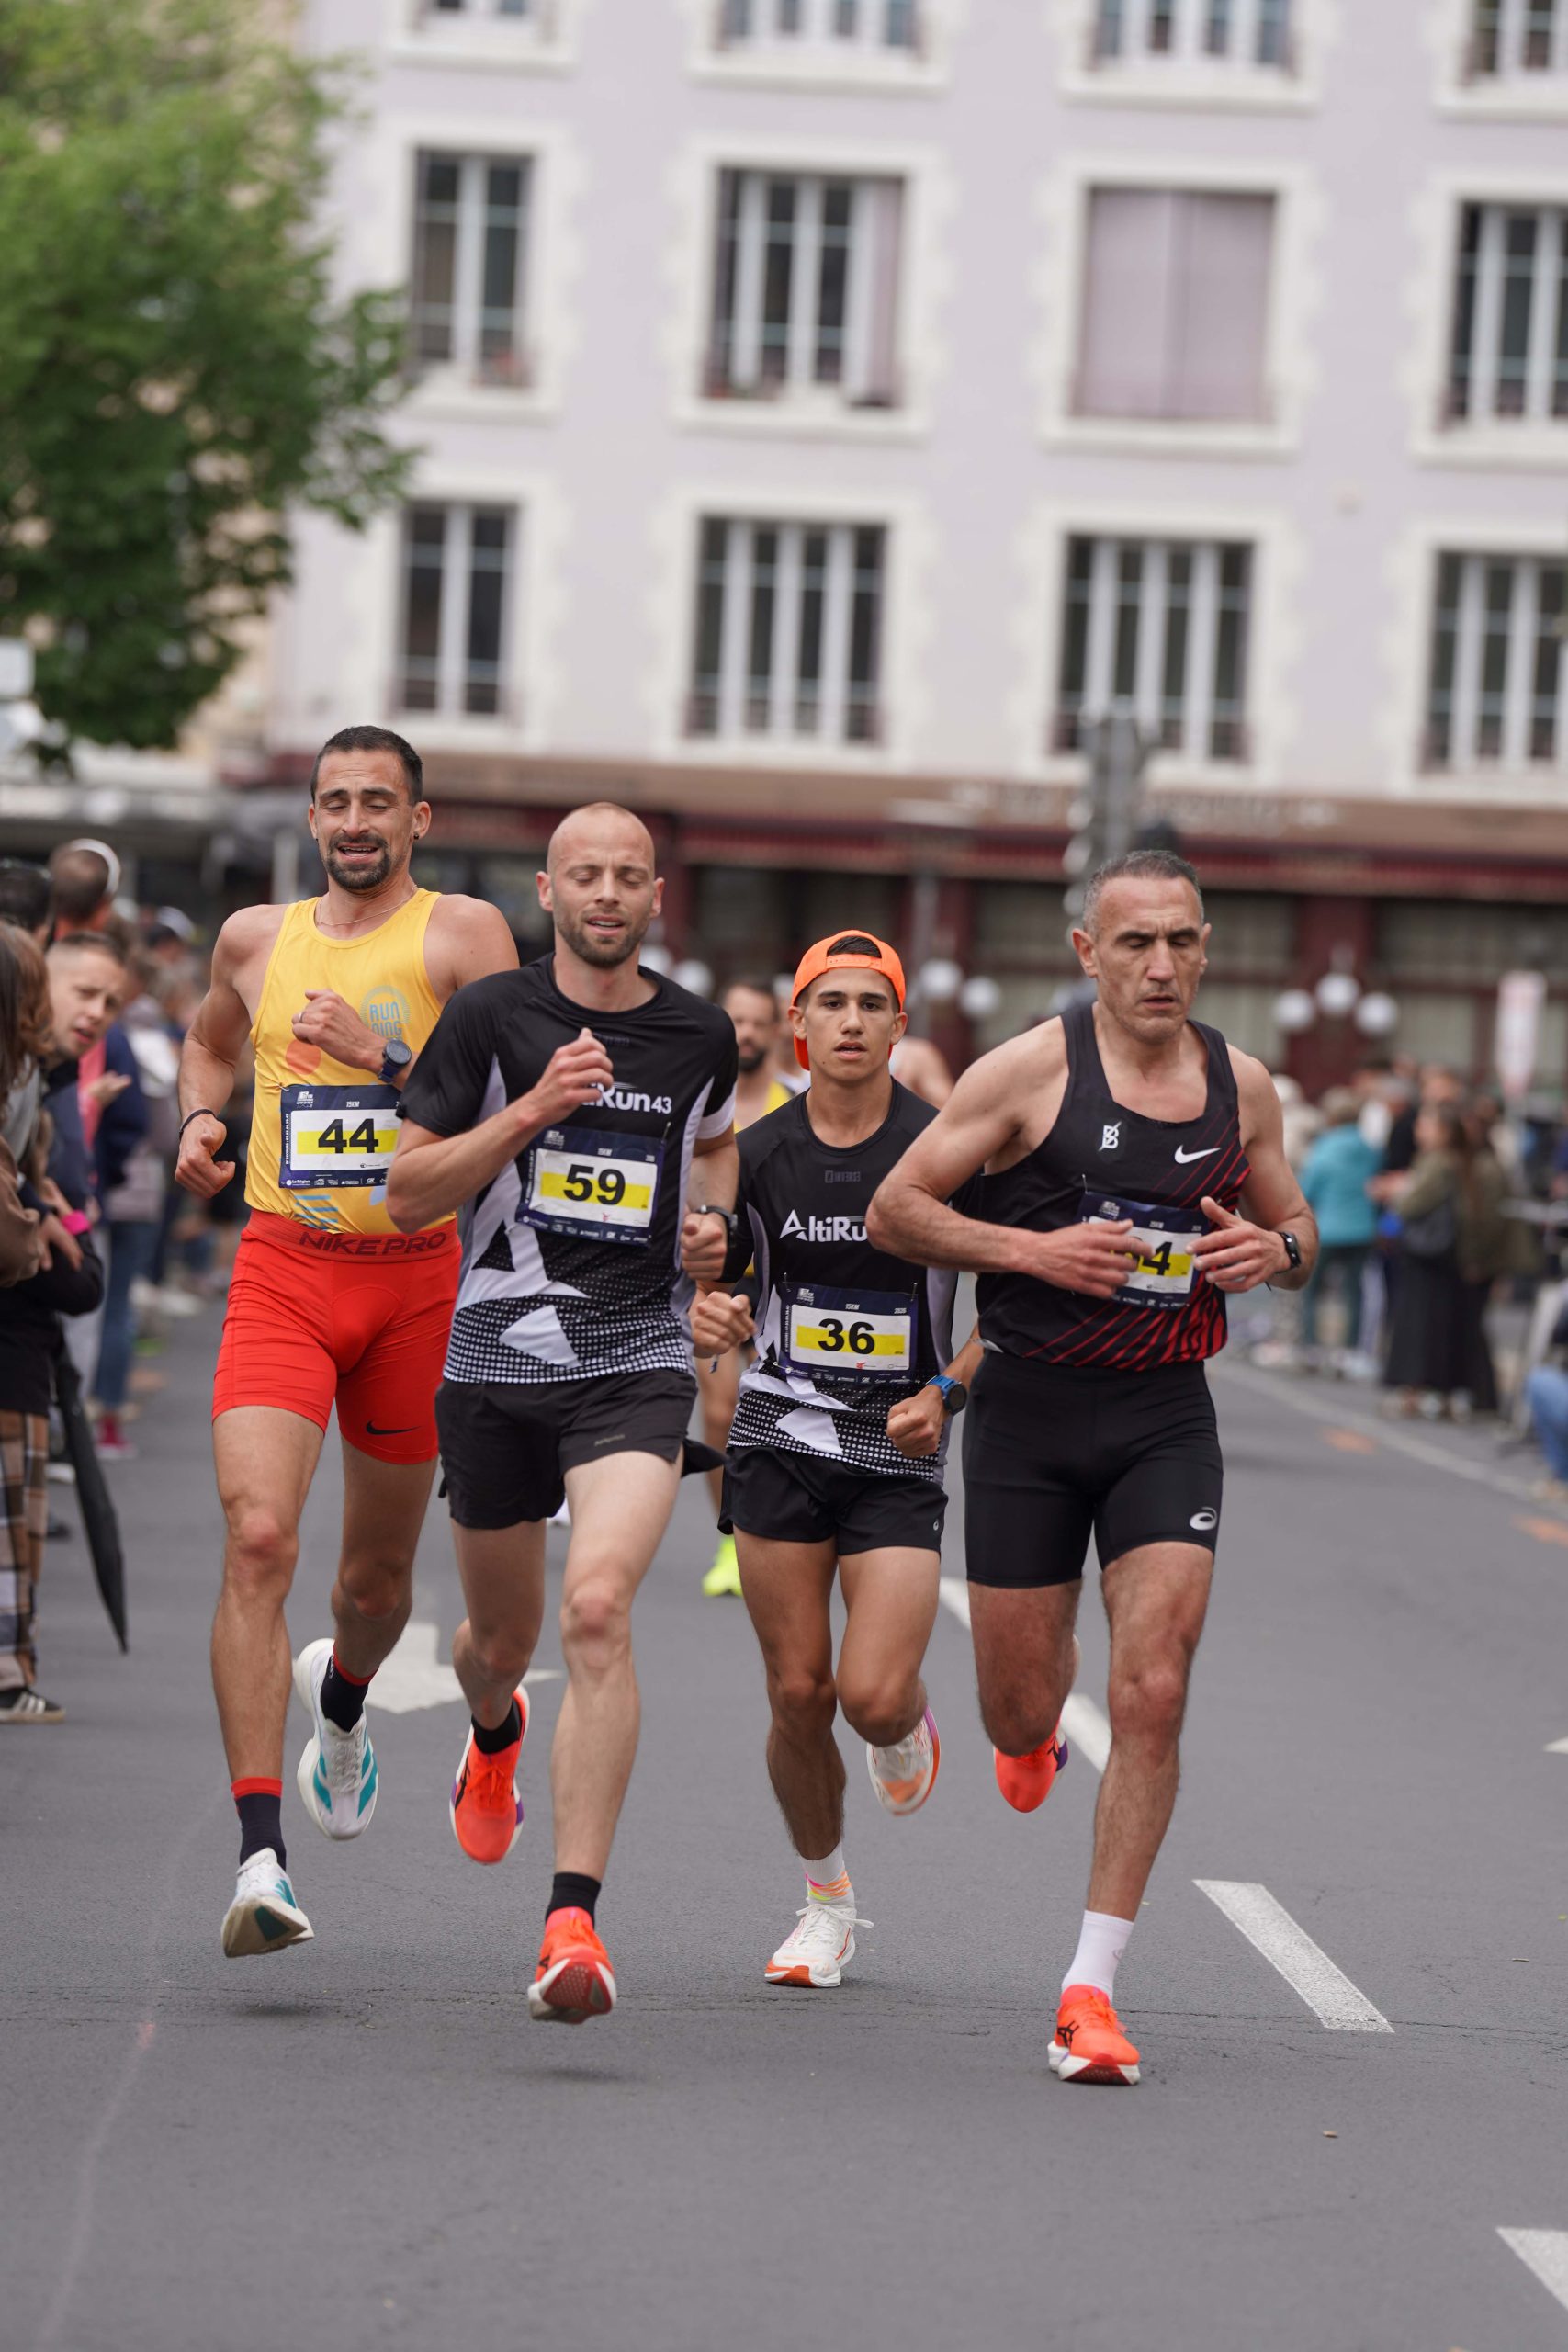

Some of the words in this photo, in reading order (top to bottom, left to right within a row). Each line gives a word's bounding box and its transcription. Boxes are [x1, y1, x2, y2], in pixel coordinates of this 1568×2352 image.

[318, 1118, 379, 1154] 44
[563, 1164, 626, 1205] 59
[299, 1231, 381, 1256] NIKE
[382, 1232, 446, 1256] PRO
[779, 1209, 868, 1243] AltiRu
[1132, 1237, 1173, 1276] 4
[818, 1318, 875, 1355] 36
